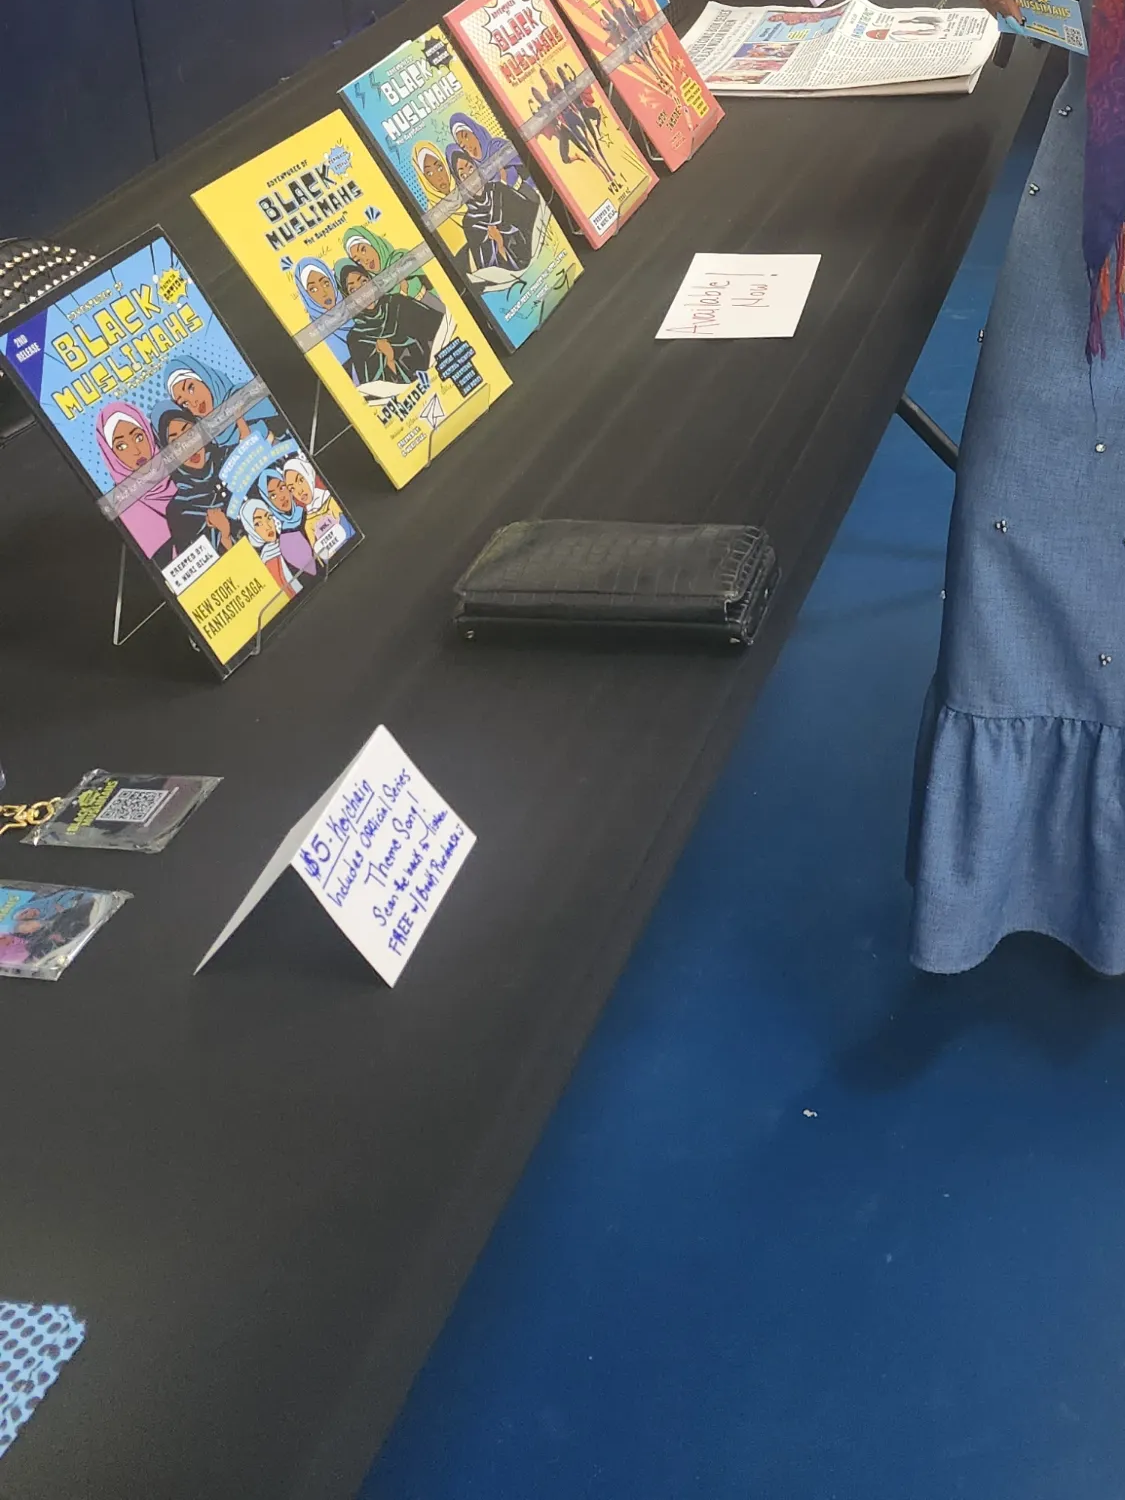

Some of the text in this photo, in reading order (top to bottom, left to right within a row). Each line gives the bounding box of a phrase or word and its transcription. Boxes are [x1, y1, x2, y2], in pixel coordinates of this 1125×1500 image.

[491, 7, 539, 52] BLACK
[499, 23, 565, 84] MUSLIMAHS
[380, 58, 433, 106] BLACK
[381, 71, 462, 141] MUSLIMAHS
[256, 162, 338, 224] BLACK
[265, 180, 364, 252] MUSLIMAHS
[51, 283, 162, 373] BLACK
[665, 280, 731, 335] Available
[13, 334, 29, 349] 2ND
[15, 342, 41, 363] RELEASE
[51, 302, 204, 421] MUSLIMAHS
[377, 395, 400, 425] LOOK
[170, 553, 197, 578] CREATED
[198, 553, 214, 569] BILAL
[192, 576, 240, 625] NEW STORY.
[203, 577, 266, 640] FANTASTIC SAGA.
[299, 778, 374, 882] $5 Keychain
[326, 849, 365, 908] Includes
[381, 767, 411, 804] Series
[363, 835, 403, 889] Theme
[371, 896, 400, 928] Scan
[388, 912, 415, 957] FREE
